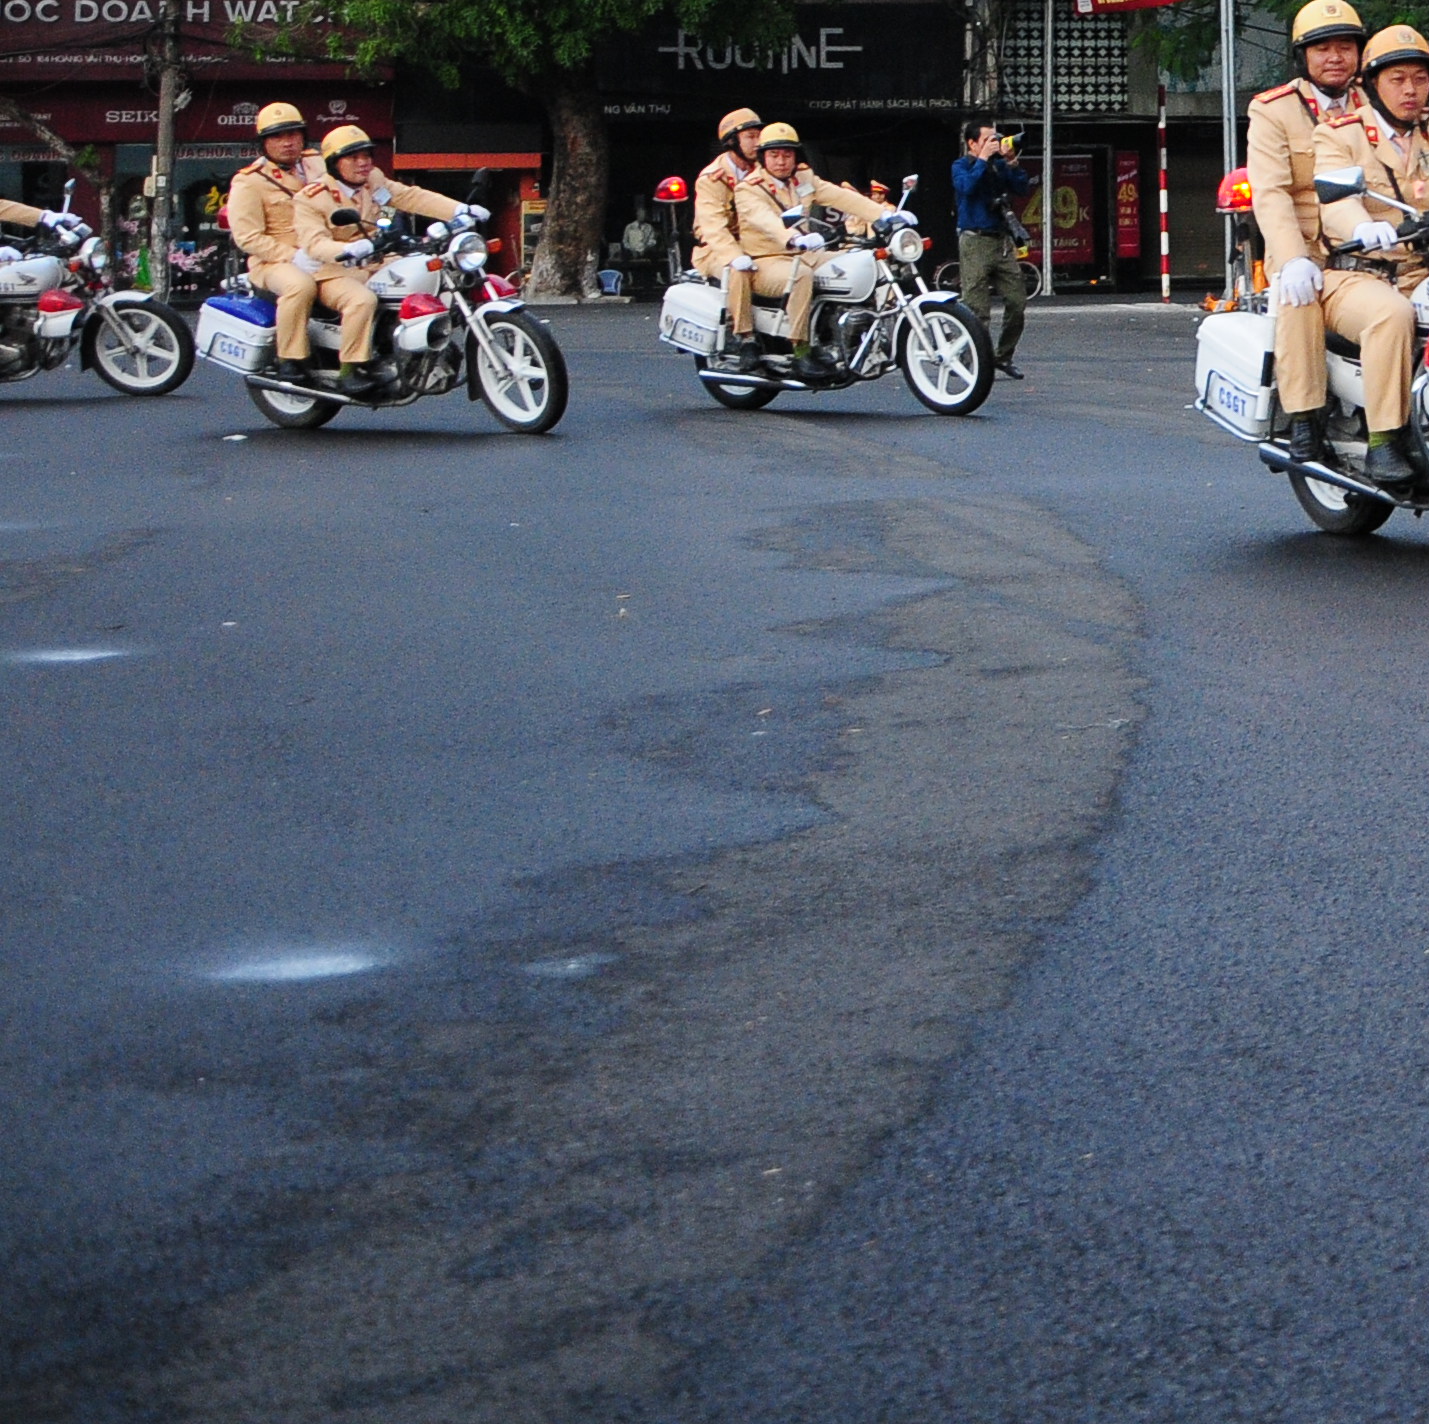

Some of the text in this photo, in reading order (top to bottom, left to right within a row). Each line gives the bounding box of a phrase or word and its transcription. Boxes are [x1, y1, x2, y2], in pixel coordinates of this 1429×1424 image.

[105, 110, 159, 123] SEIK
[217, 114, 258, 125] ORIE
[1218, 386, 1248, 418] CSGT
